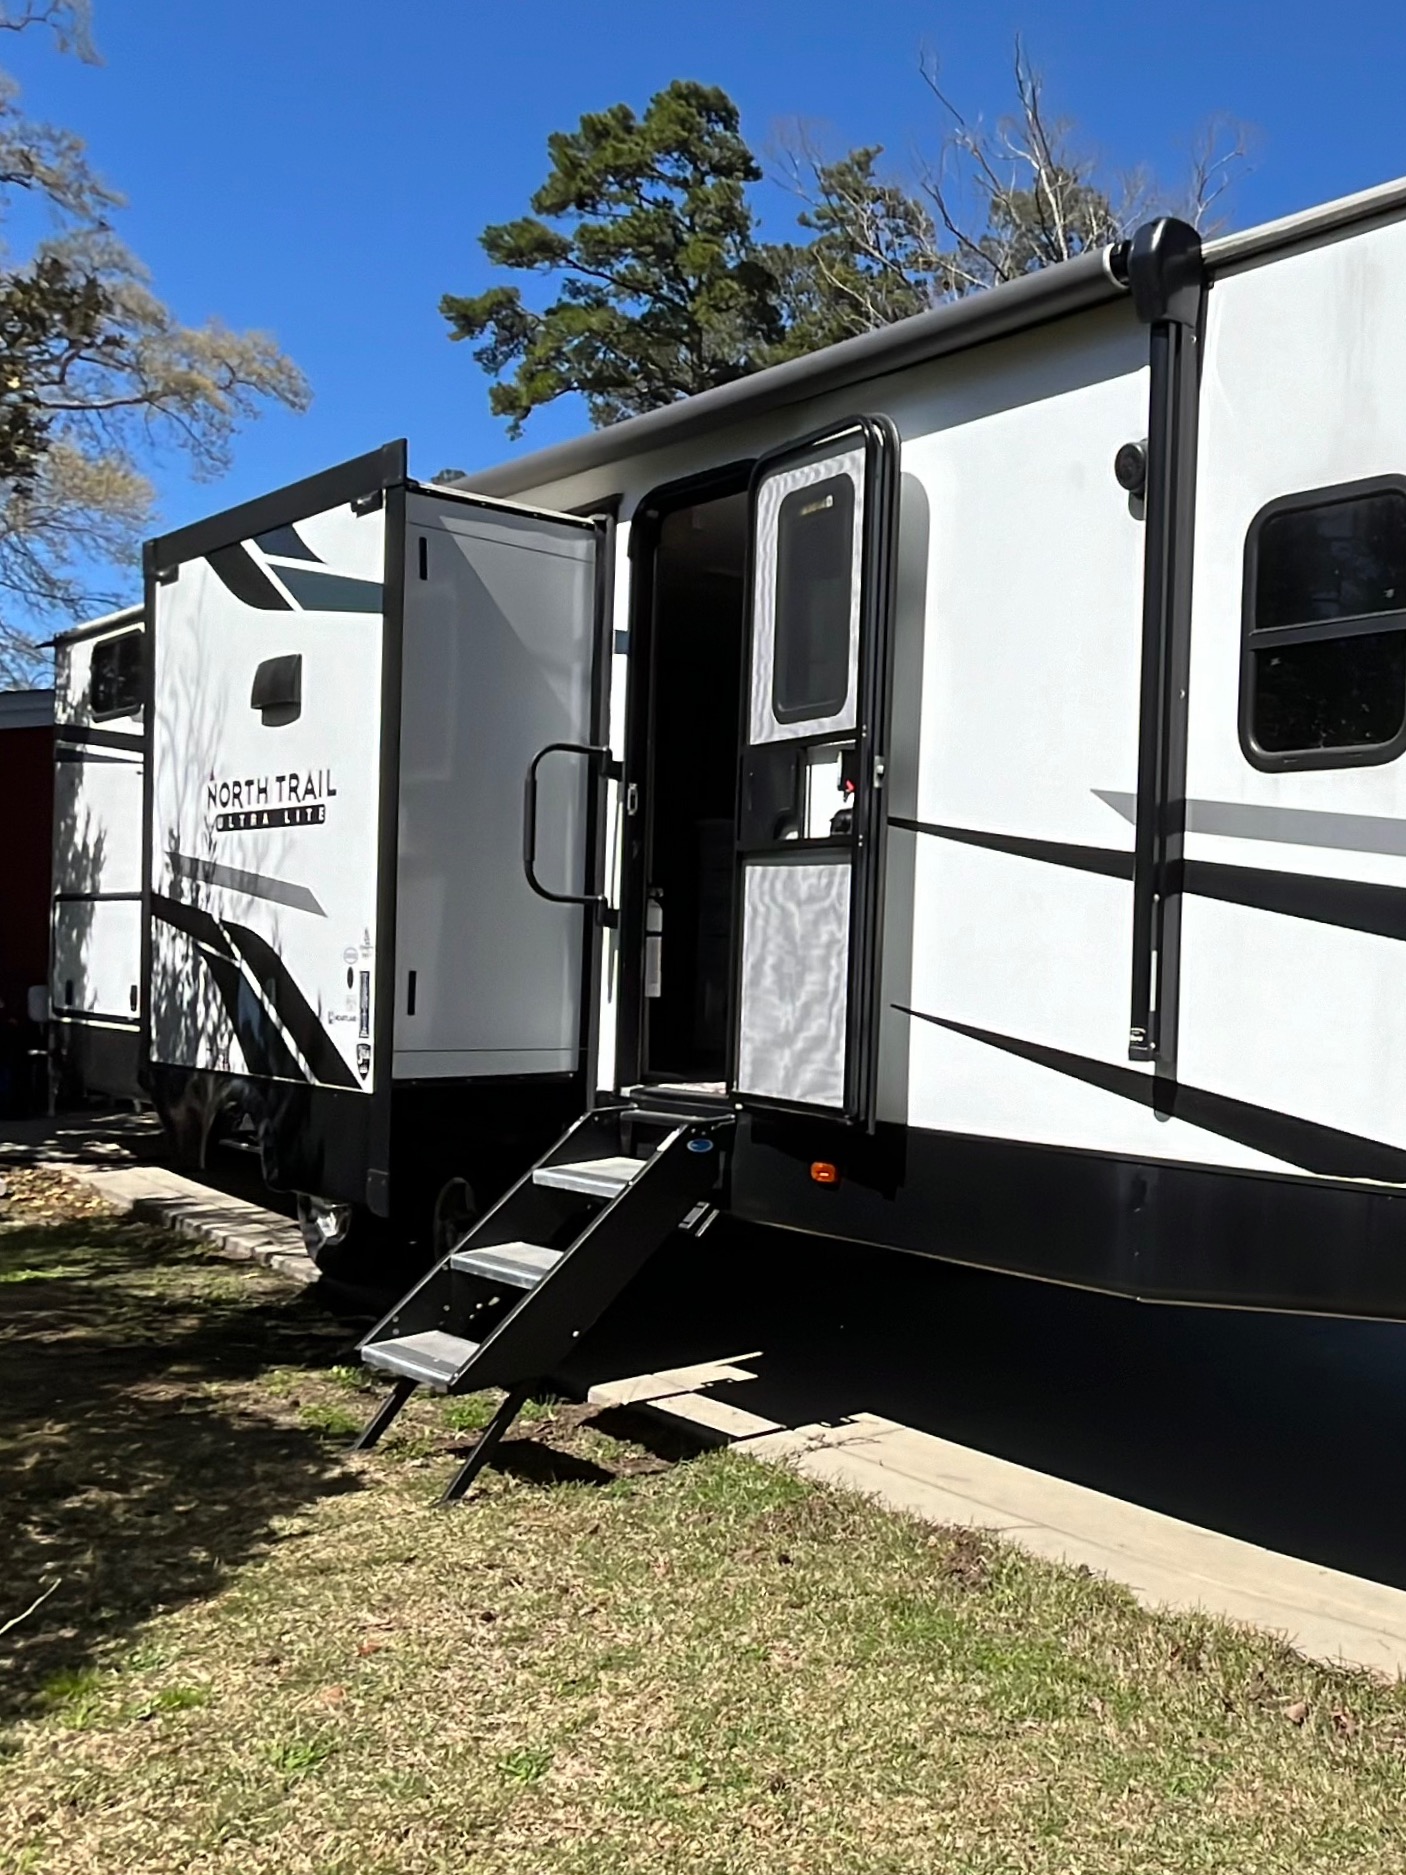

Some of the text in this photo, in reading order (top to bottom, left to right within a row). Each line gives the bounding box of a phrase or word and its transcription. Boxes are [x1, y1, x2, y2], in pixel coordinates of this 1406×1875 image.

[208, 769, 337, 809] NORTH TRAIL
[216, 806, 325, 830] ULTRA LITE
